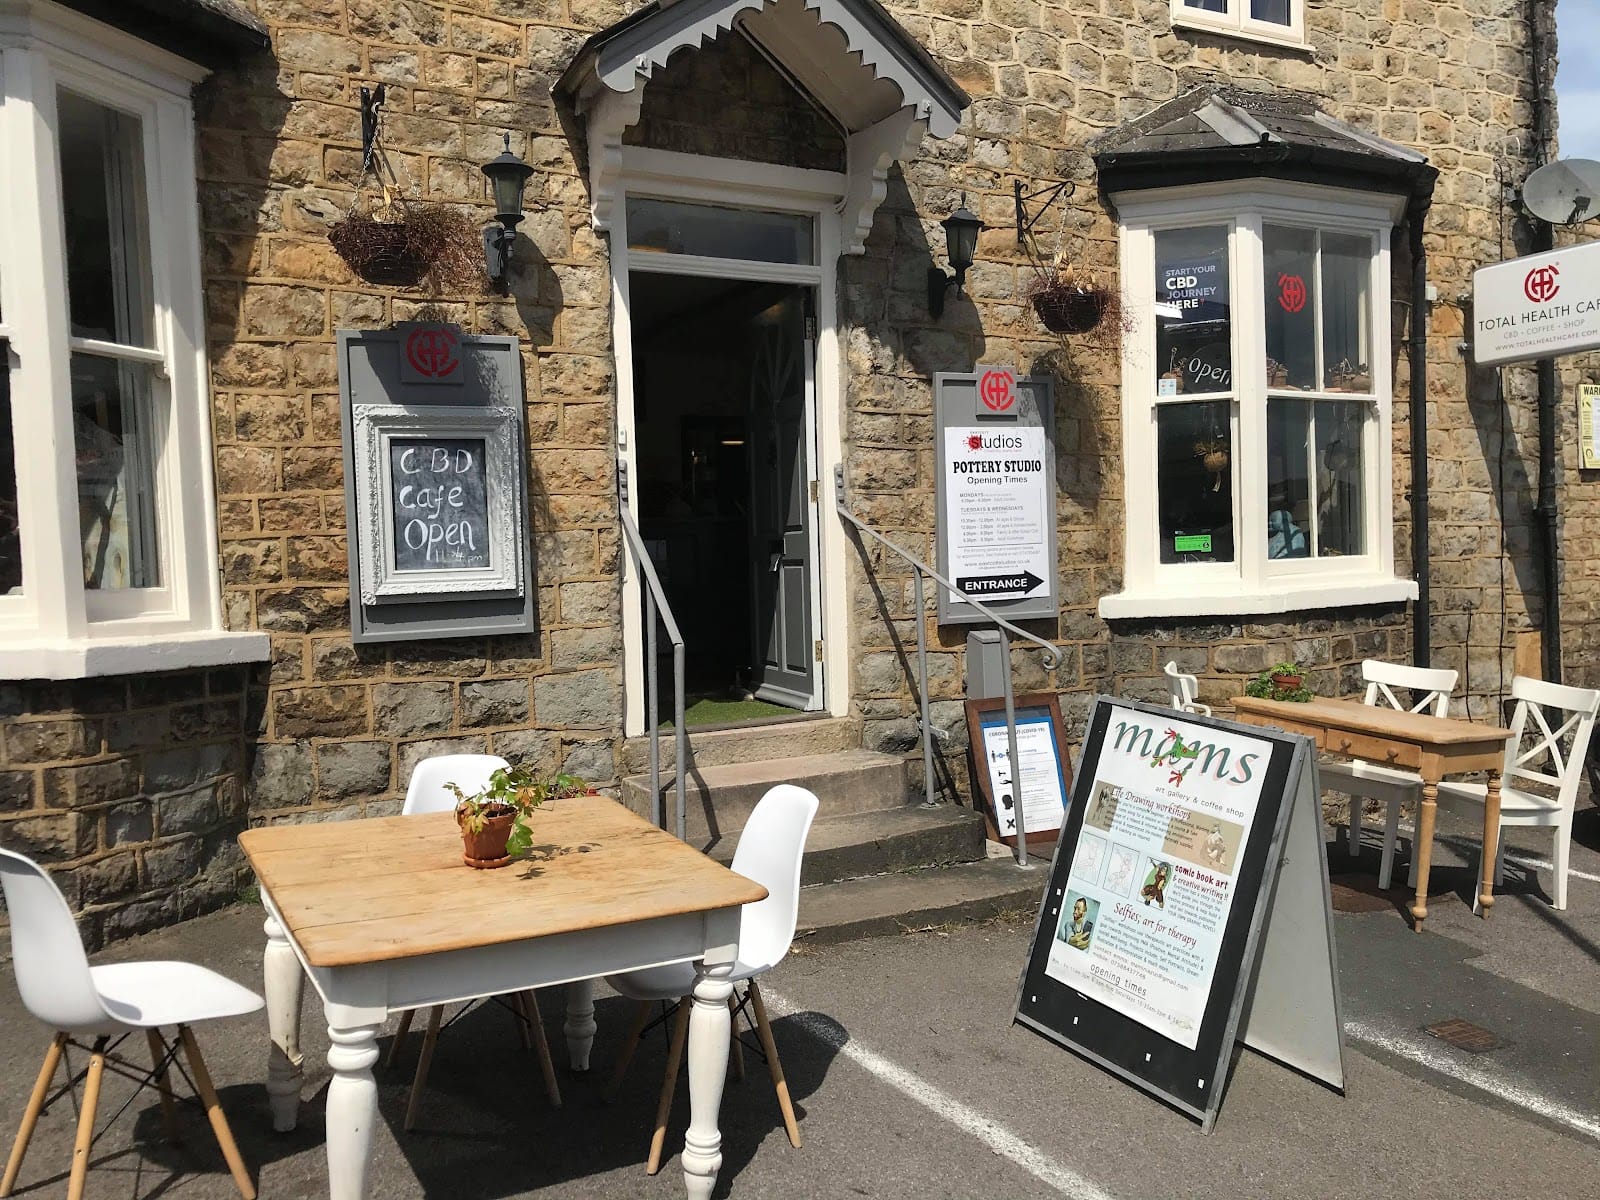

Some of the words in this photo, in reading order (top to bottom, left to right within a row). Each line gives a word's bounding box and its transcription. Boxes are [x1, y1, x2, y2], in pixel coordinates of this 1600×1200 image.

[1166, 267, 1191, 277] START
[1191, 265, 1216, 274] YOUR
[1165, 276, 1198, 290] CBD
[1166, 286, 1217, 300] JOURNEY
[1166, 298, 1199, 310] HERE
[1479, 315, 1516, 332] TOTAL
[1521, 305, 1570, 324] HEALTH
[1503, 330, 1518, 340] CBD
[1526, 324, 1555, 336] COFFEE
[1564, 319, 1585, 329] SHOP
[969, 434, 1023, 449] studios
[400, 447, 473, 474] CBD
[953, 460, 1002, 474] POTTERY
[1004, 460, 1042, 473] STUDIO
[967, 476, 1002, 485] Opening
[1004, 475, 1028, 484] Times
[404, 519, 476, 561] Open
[964, 578, 1028, 591] ENTRANCE
[1111, 785, 1123, 798] Life
[1124, 791, 1154, 810] Drawing
[1156, 799, 1192, 822] workshops
[1167, 790, 1190, 802] gallery
[1200, 800, 1223, 810] coffee
[1225, 807, 1244, 818] shop
[1175, 864, 1195, 877] comic
[1196, 871, 1214, 884] book
[1215, 879, 1228, 890] art
[1178, 877, 1200, 890] creative
[1113, 900, 1142, 928] Selfies;
[1142, 917, 1154, 928] art
[1153, 918, 1168, 938] for
[1167, 924, 1198, 951] therapy
[1090, 963, 1121, 986] opening
[1125, 979, 1147, 996] times
